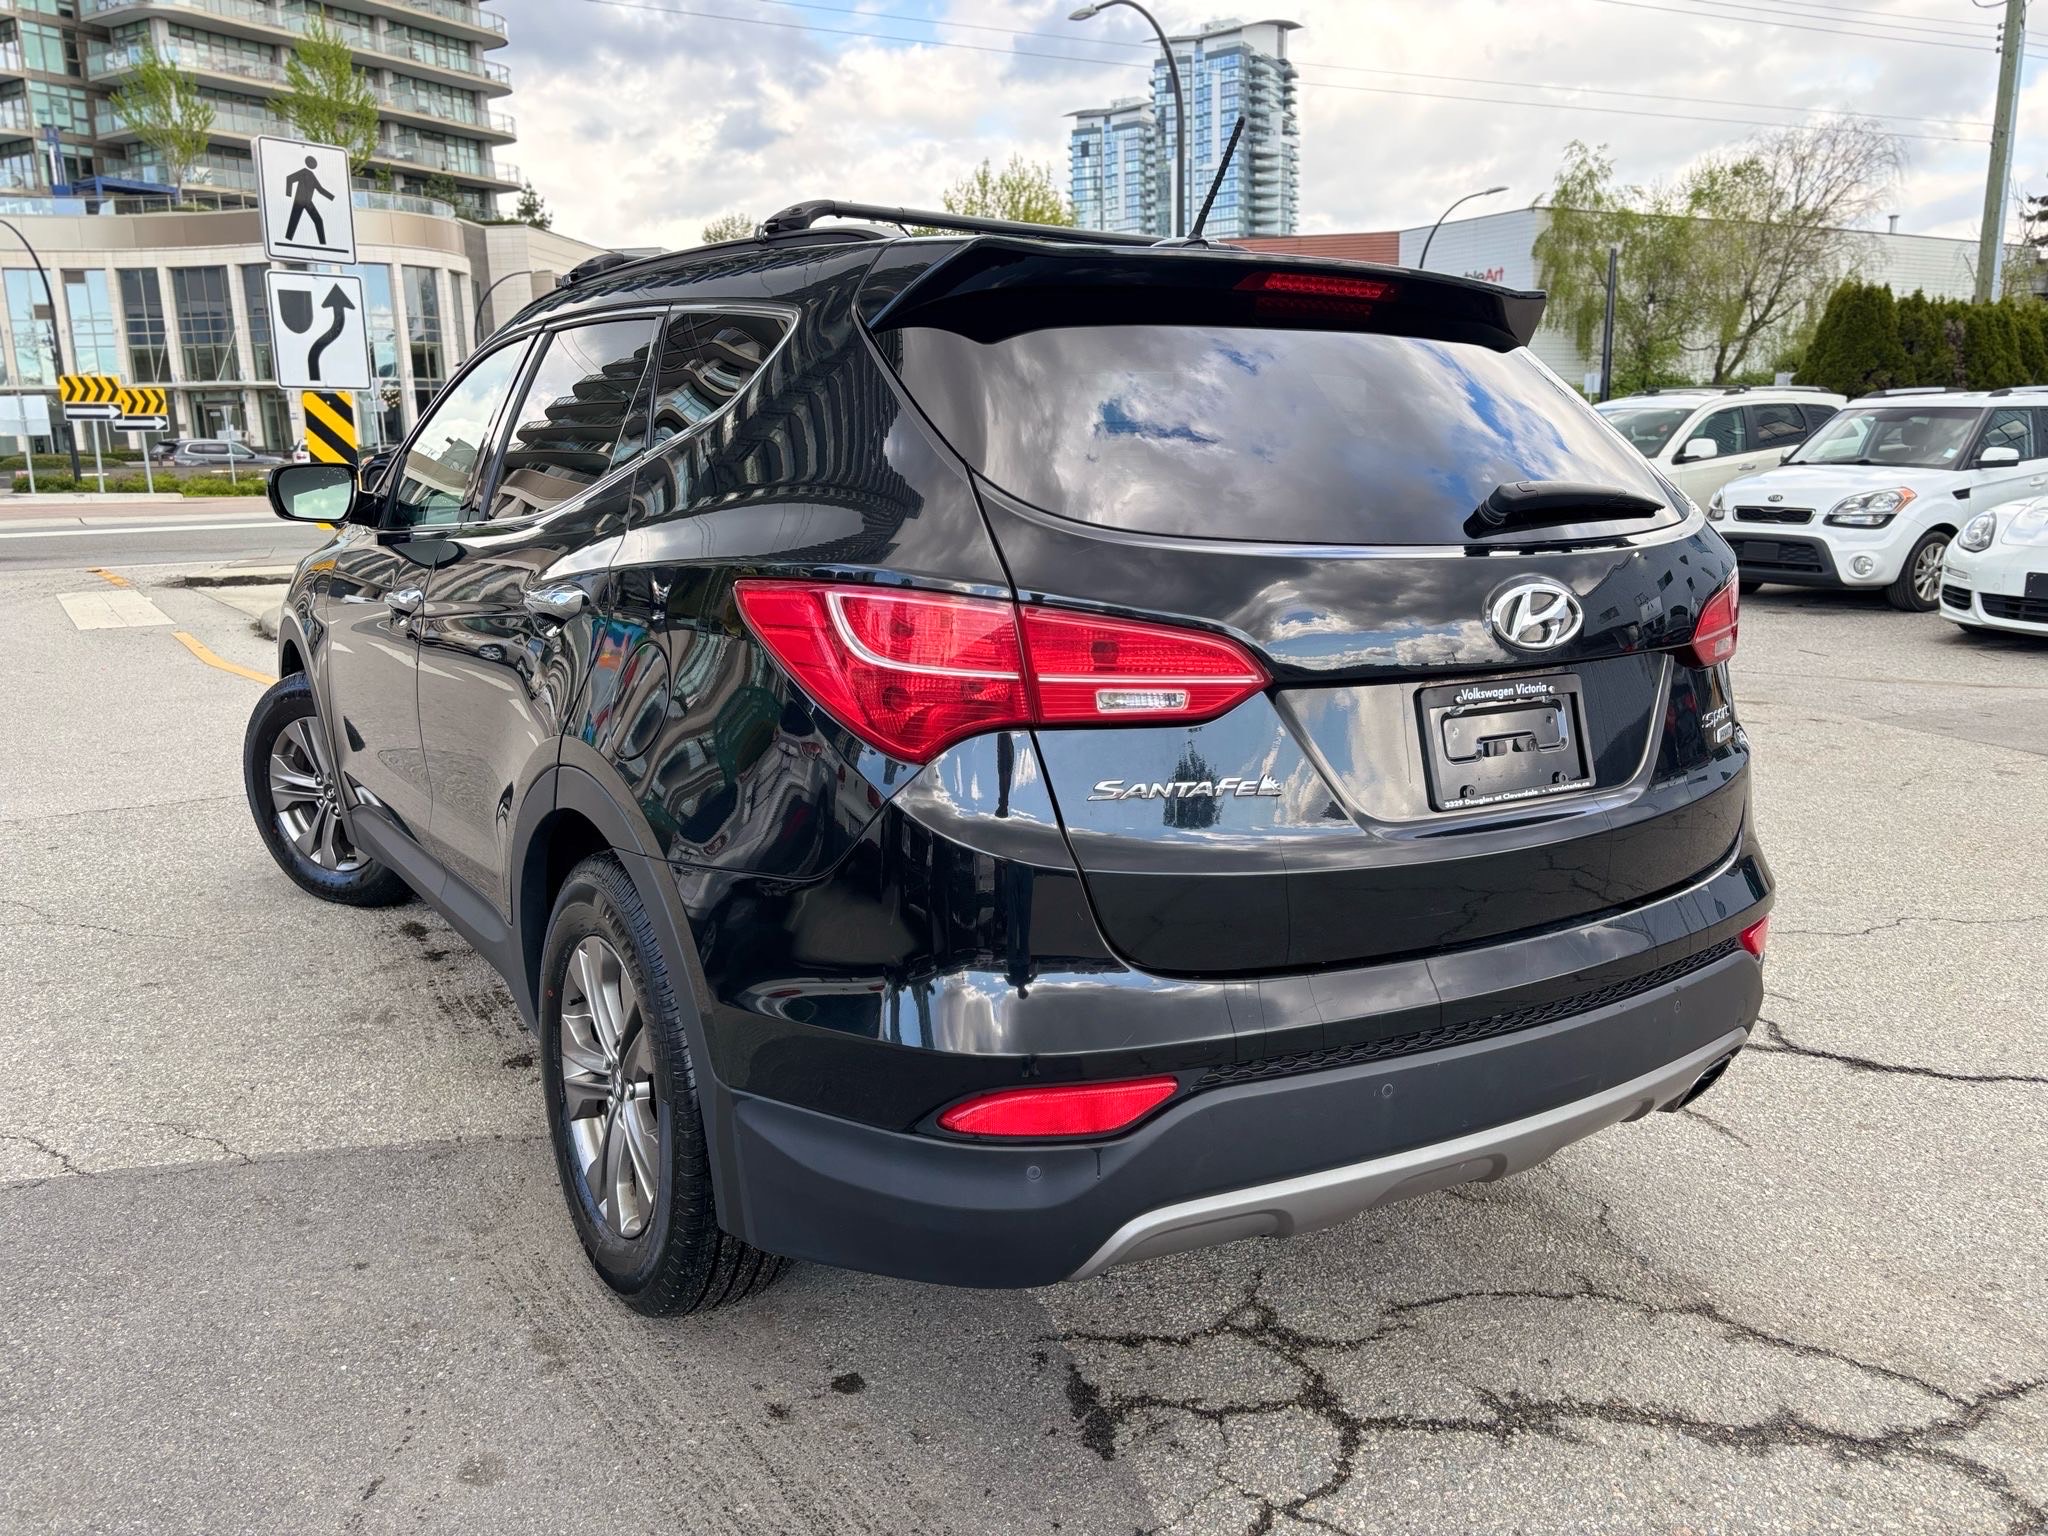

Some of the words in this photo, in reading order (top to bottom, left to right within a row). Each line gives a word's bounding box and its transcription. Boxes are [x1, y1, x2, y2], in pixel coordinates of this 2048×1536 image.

[1461, 688, 1513, 700] Volkswagen
[1515, 682, 1547, 694] Victoria
[1445, 799, 1463, 808] 3329
[1465, 796, 1493, 804] Douglas
[1503, 789, 1538, 799] Cloverdale
